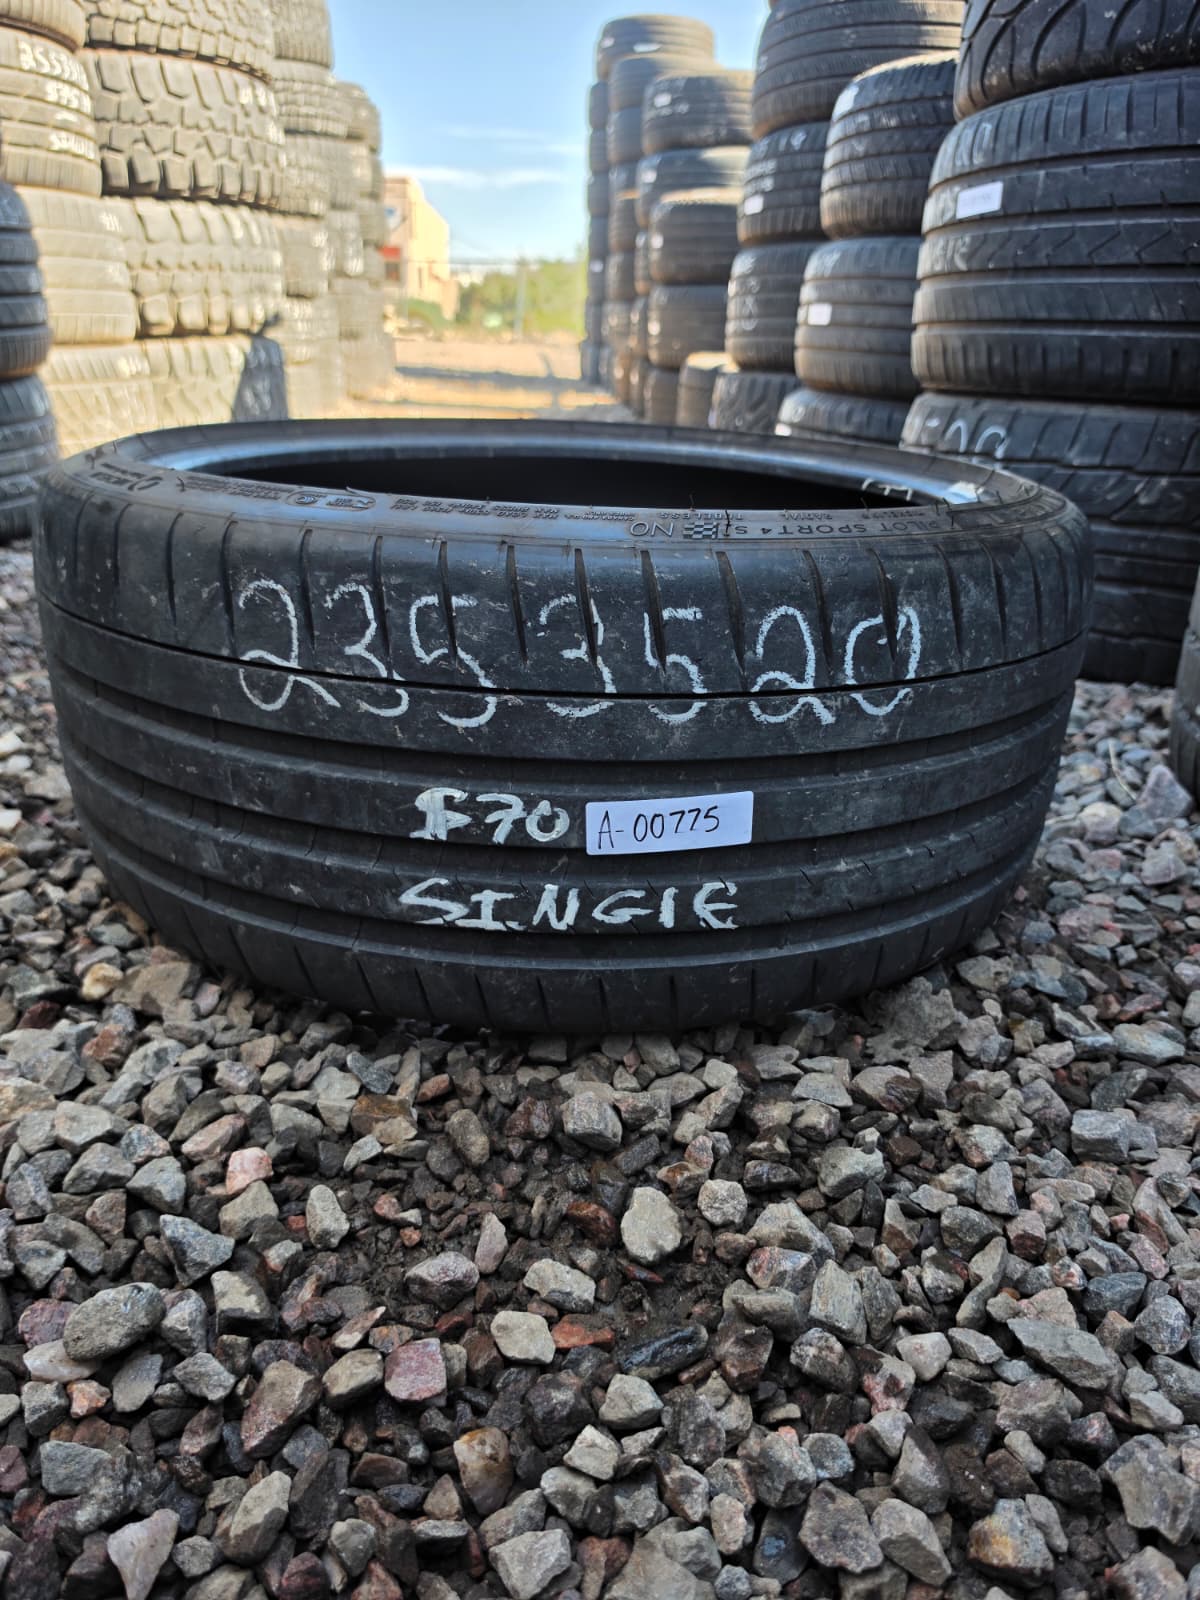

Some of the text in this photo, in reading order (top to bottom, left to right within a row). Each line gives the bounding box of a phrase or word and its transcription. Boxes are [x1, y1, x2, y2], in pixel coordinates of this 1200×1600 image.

[779, 523, 867, 535] SPORT
[880, 520, 940, 532] PILOT
[239, 578, 499, 728] 235
[750, 605, 922, 725] 20
[597, 805, 721, 850] A-00775
